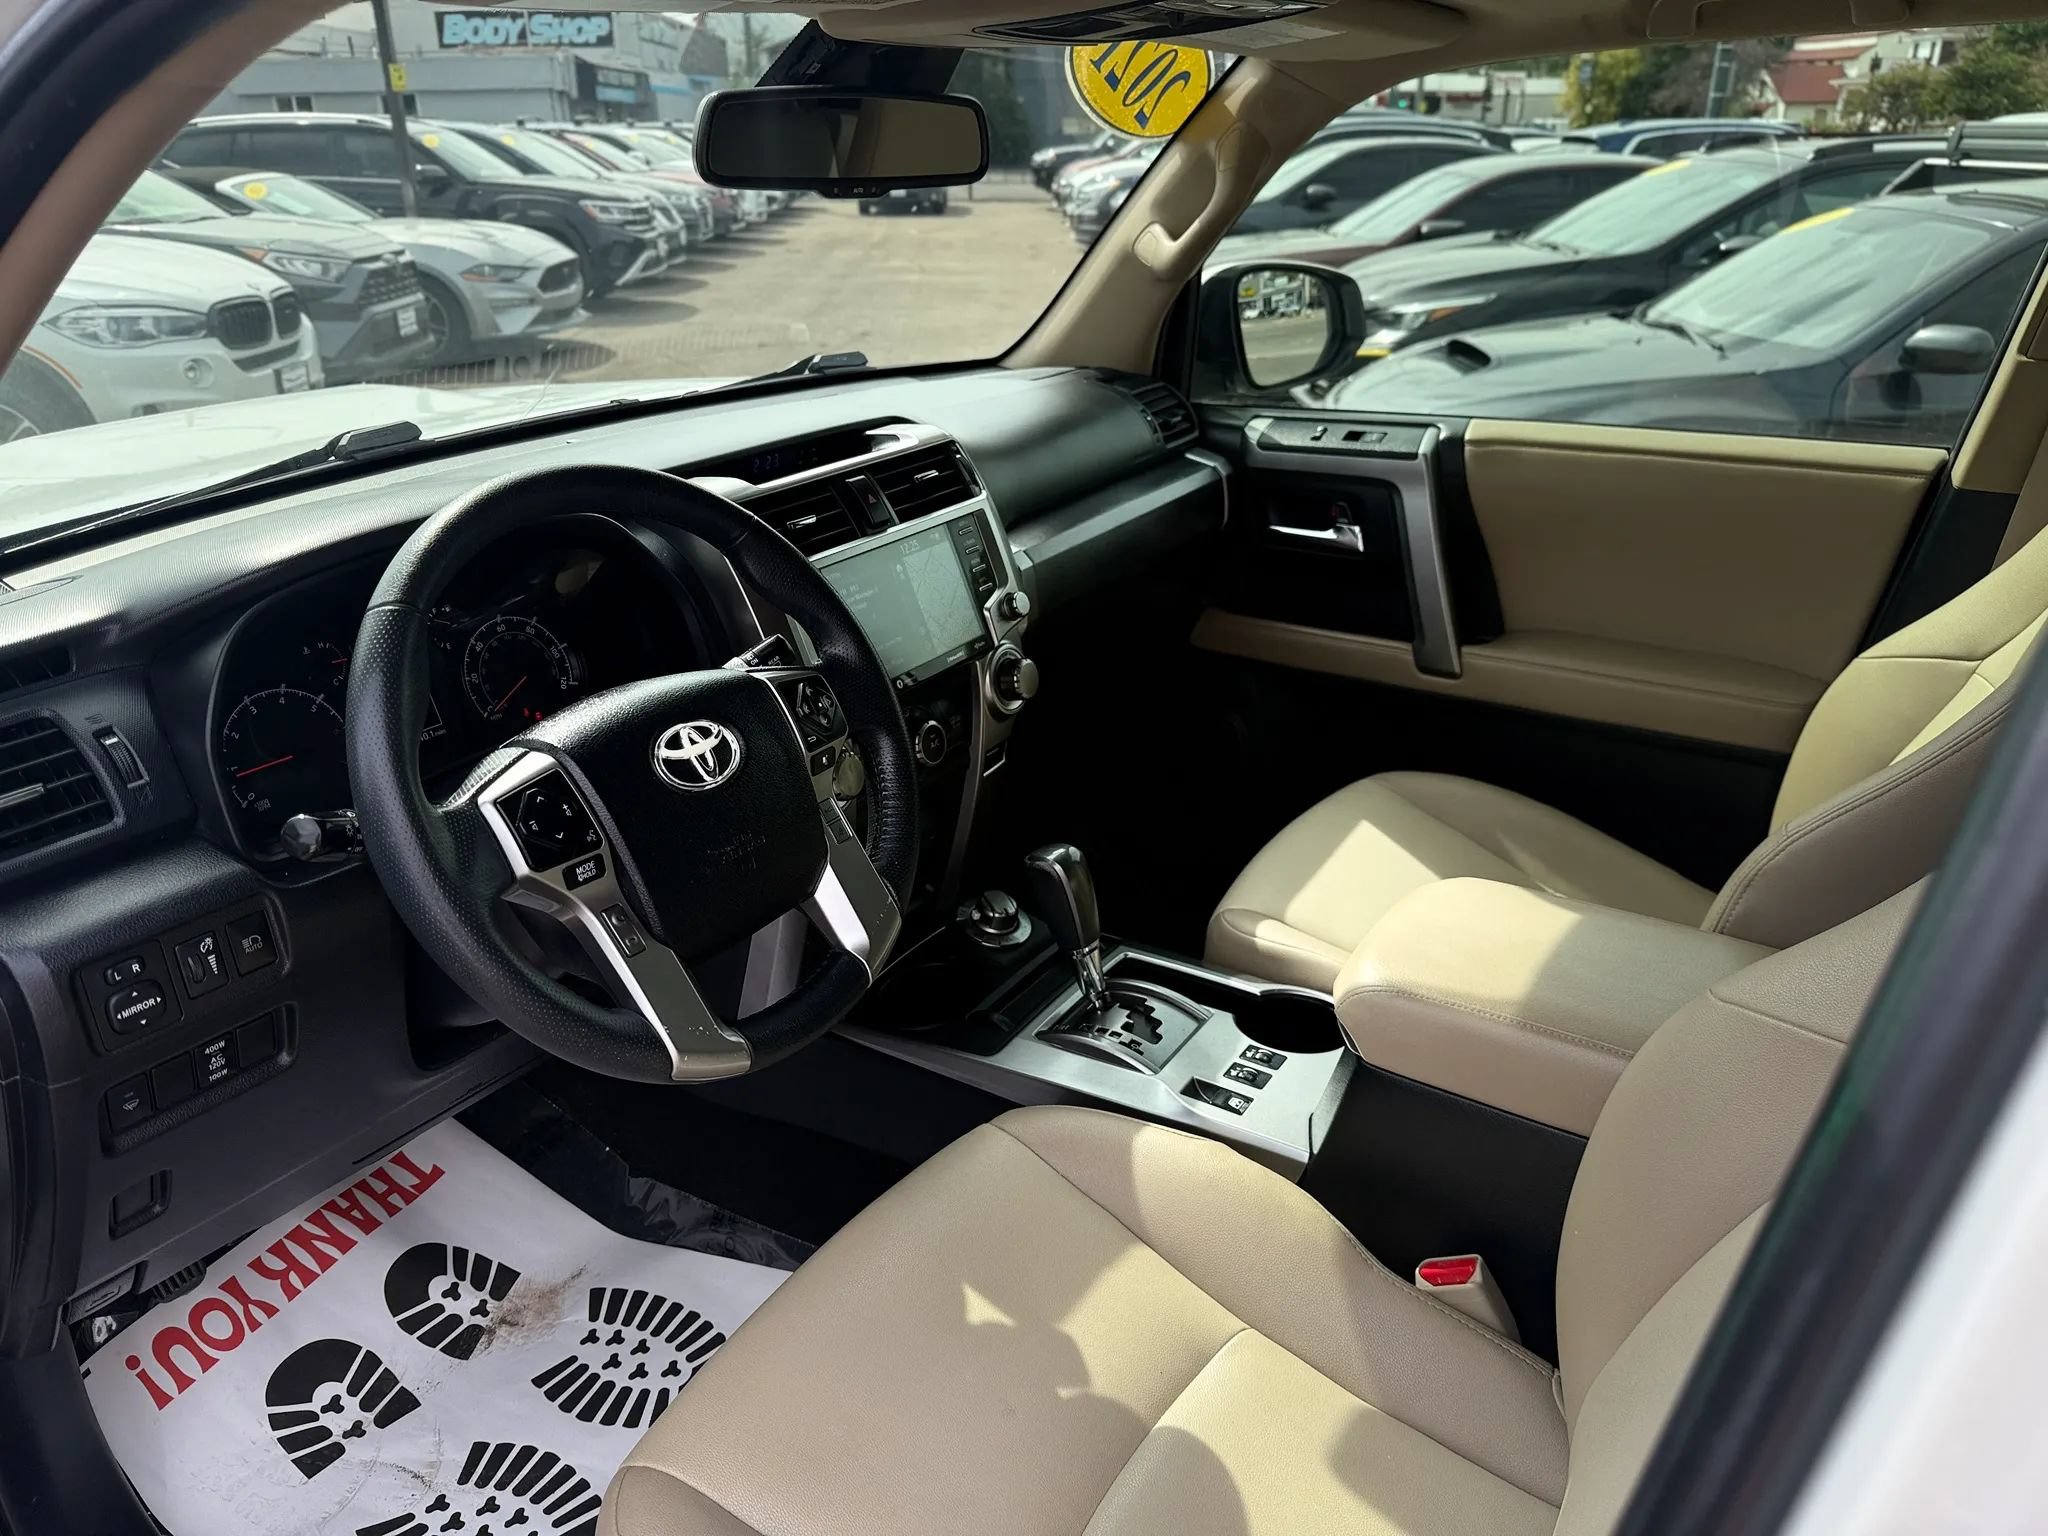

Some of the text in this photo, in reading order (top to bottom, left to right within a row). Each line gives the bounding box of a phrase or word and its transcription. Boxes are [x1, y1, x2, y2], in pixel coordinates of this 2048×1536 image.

[496, 624, 506, 633] 60
[525, 625, 535, 635] 80
[475, 641, 484, 652] 40
[550, 646, 561, 659] 100
[471, 673, 479, 684] 20
[279, 696, 286, 705] 4
[249, 705, 258, 715] 3
[310, 704, 318, 713] 5
[231, 731, 240, 740] 2
[247, 792, 255, 801] 0
[575, 860, 596, 875] MODE
[245, 941, 263, 954] AUTO
[131, 963, 141, 975] R
[114, 972, 122, 981] L
[121, 998, 156, 1020] MIRROR
[204, 1039, 226, 1055] 400W
[208, 1058, 226, 1071] 120V
[210, 1054, 224, 1065] AC
[208, 1068, 228, 1082] 100W
[125, 1150, 446, 1411] THANK YOU!
